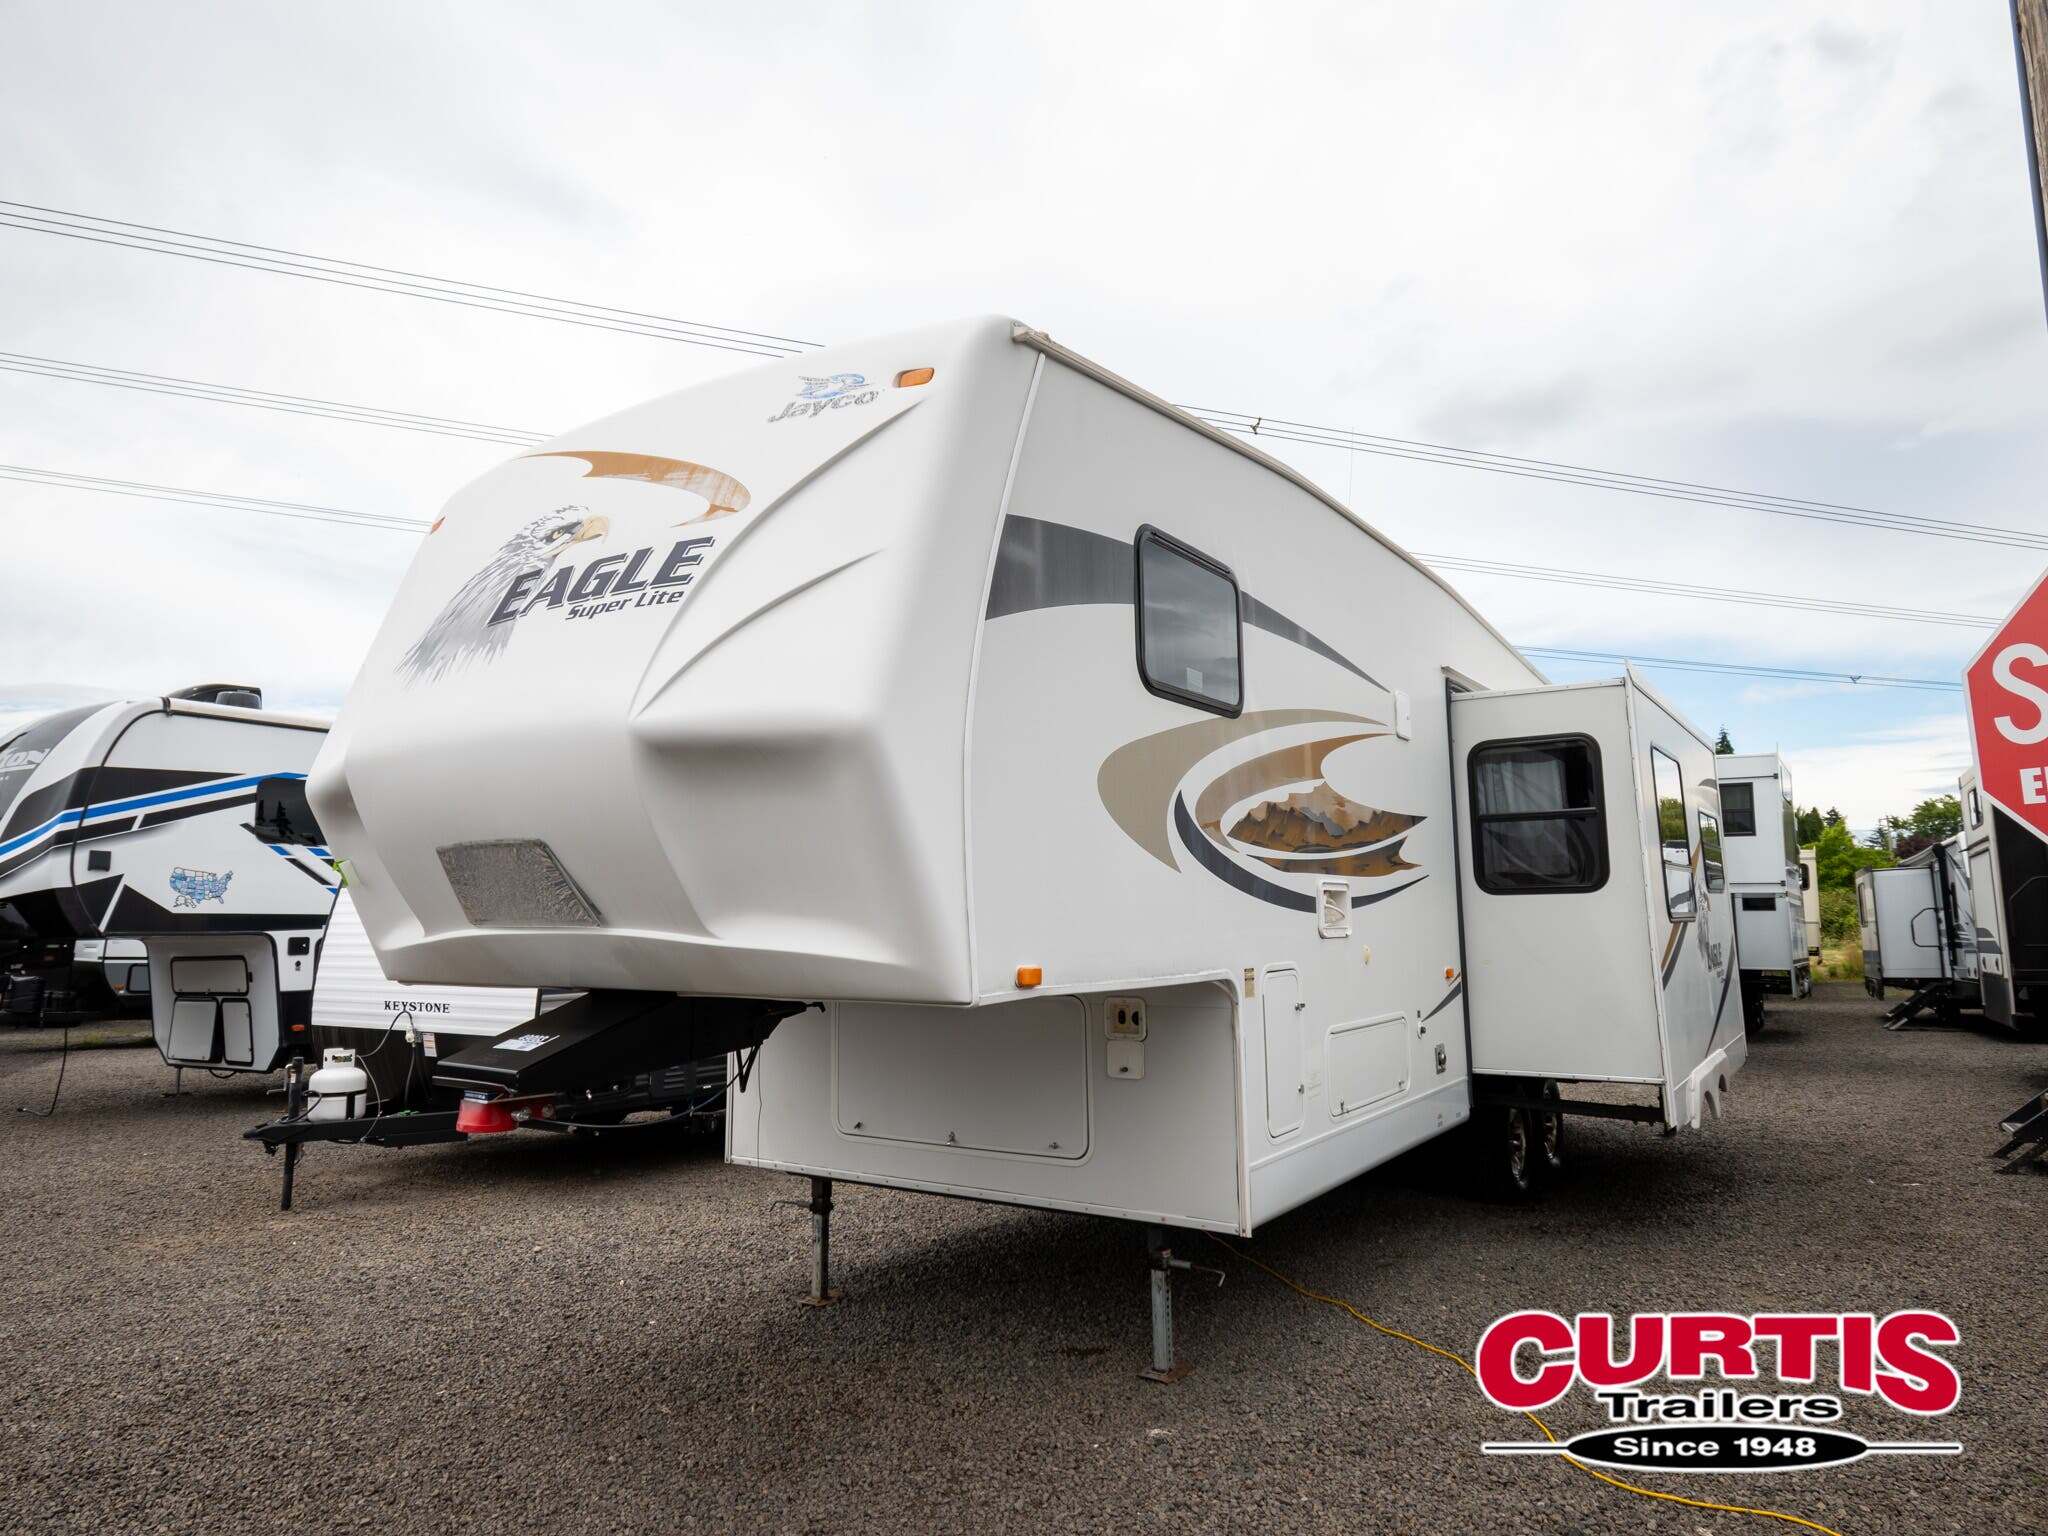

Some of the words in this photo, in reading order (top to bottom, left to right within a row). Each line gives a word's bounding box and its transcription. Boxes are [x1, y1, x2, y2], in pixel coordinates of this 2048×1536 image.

[767, 390, 880, 423] Jayco
[487, 535, 715, 627] EAGLE
[565, 598, 633, 621] Super
[634, 590, 685, 608] Lite
[2019, 766, 2048, 805] E
[384, 1000, 451, 1014] KEYSTONE
